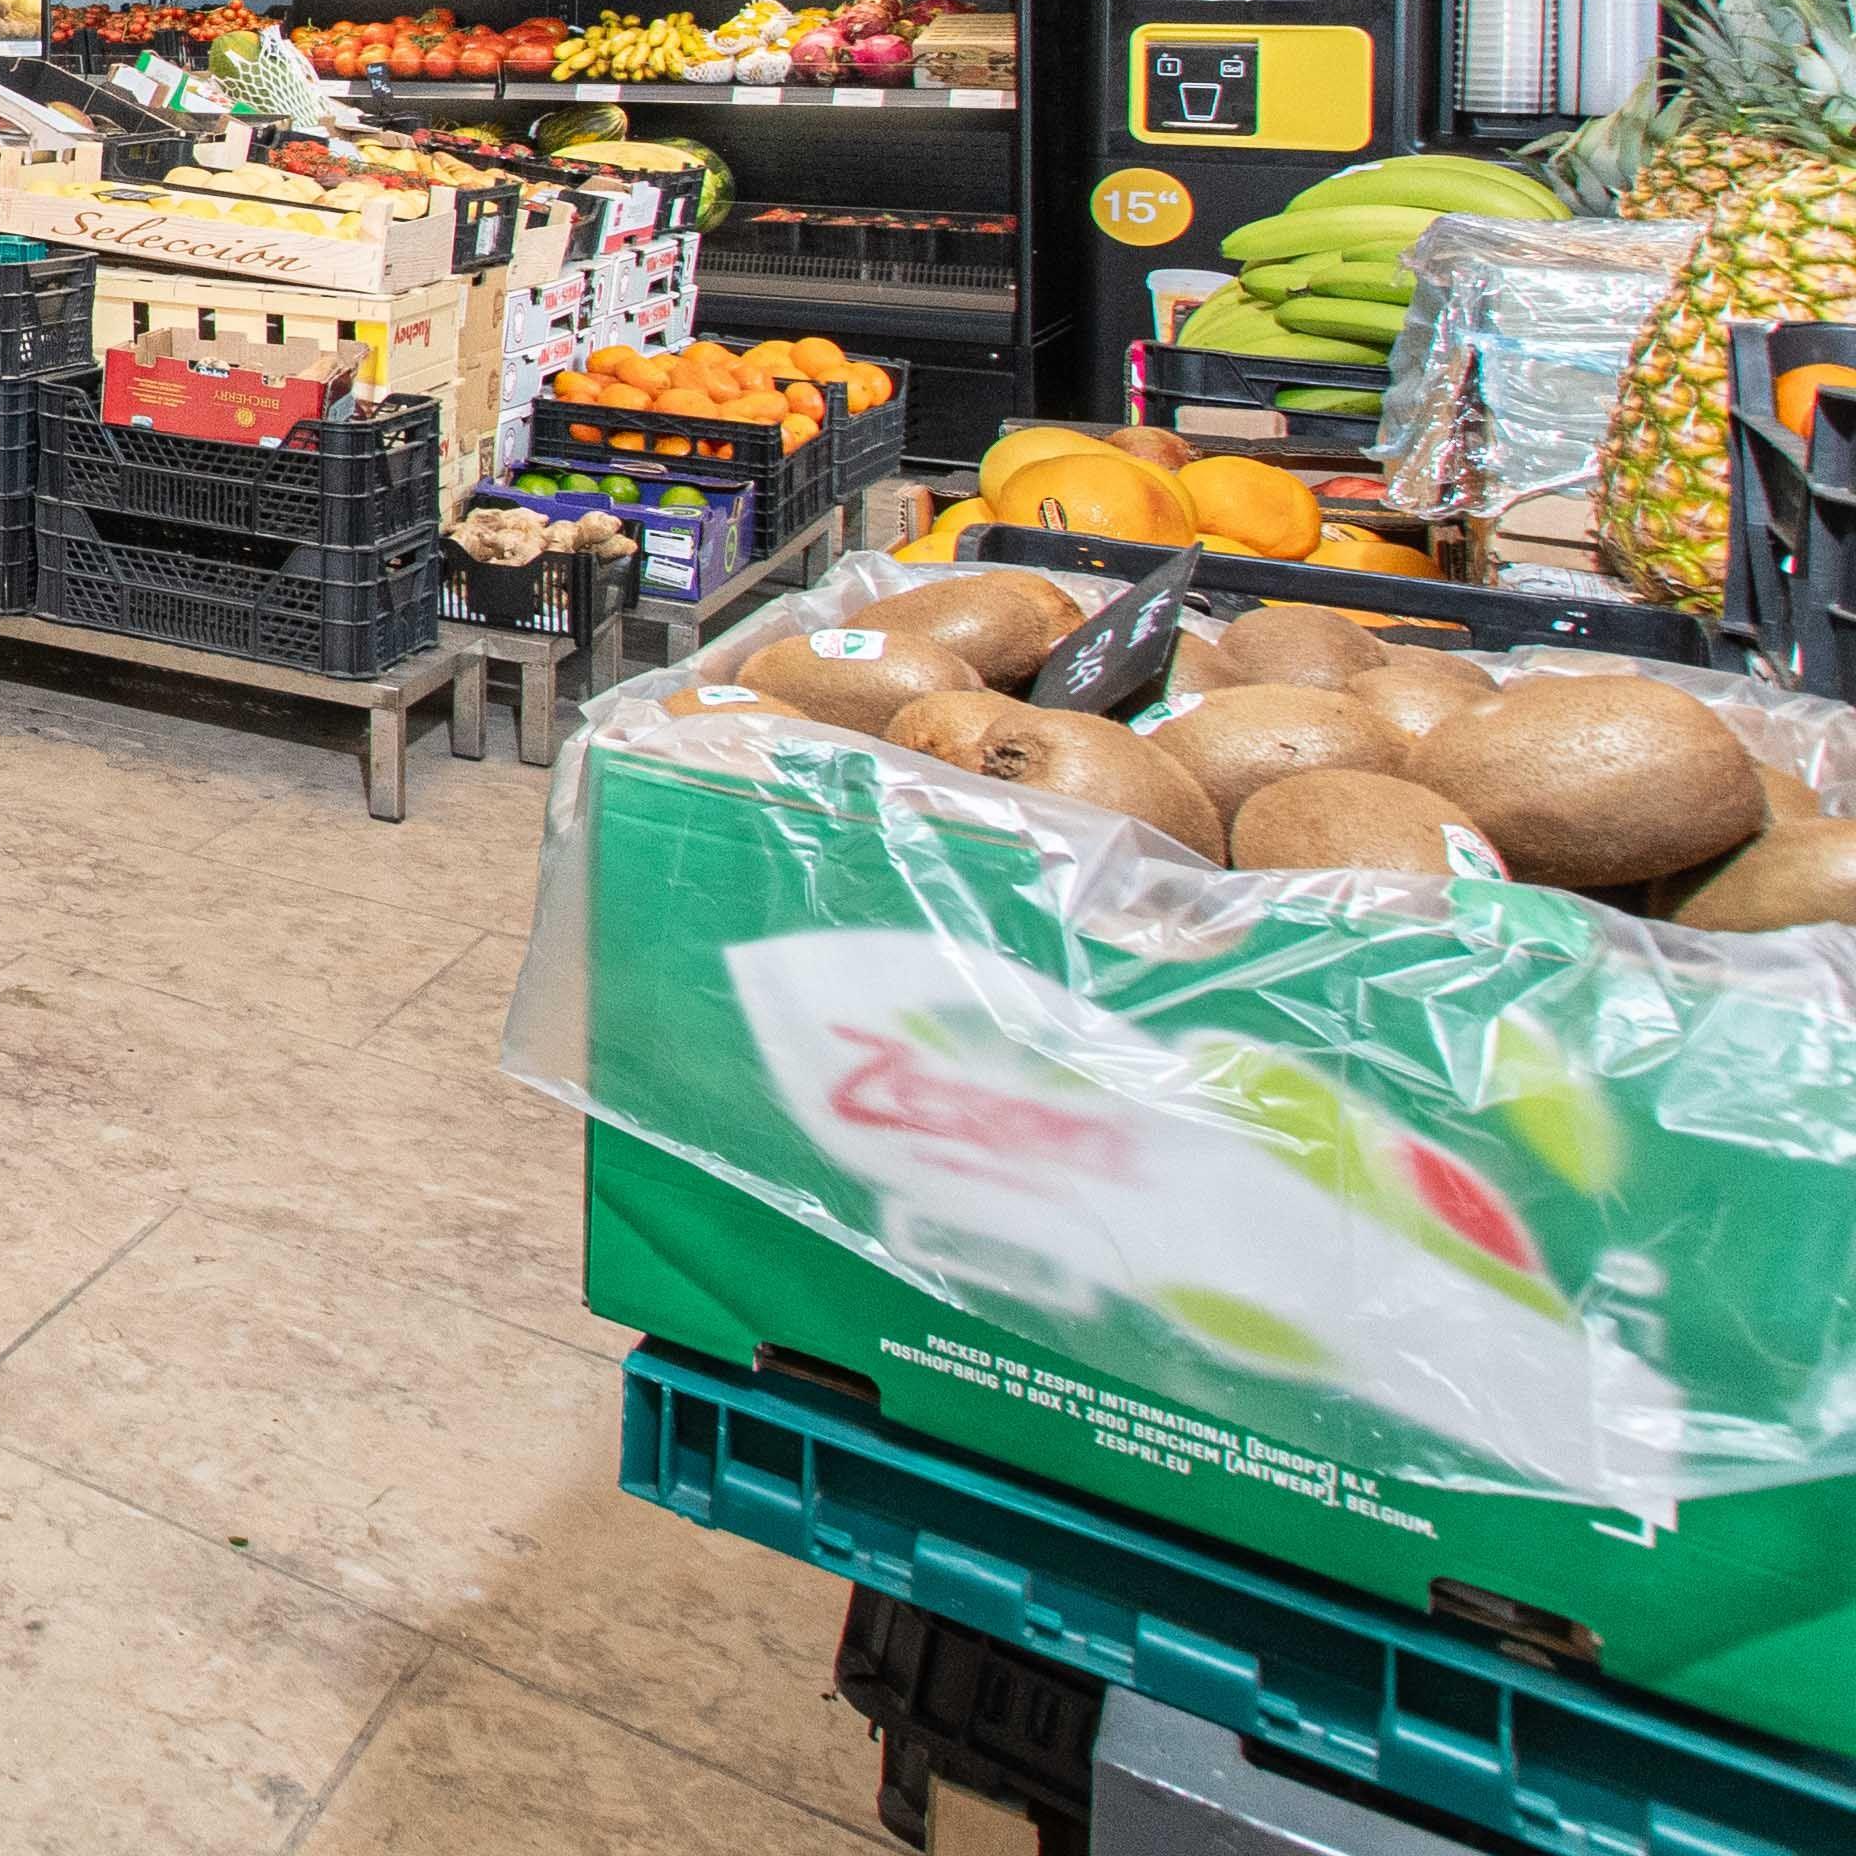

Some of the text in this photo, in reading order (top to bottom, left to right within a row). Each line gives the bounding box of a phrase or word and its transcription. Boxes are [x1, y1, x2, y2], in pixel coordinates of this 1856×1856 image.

[51, 211, 312, 273] Selección
[213, 388, 281, 411] BIRCHERRY
[880, 1337, 1000, 1390] POSTHOFBRUG
[1004, 1379, 1025, 1398] 10
[1027, 1386, 1062, 1413] BOX
[1085, 1406, 1130, 1433] 2600
[1133, 1422, 1222, 1465] BERCHEM
[927, 1333, 992, 1368] PACKED
[995, 1356, 1030, 1381] FOR
[1034, 1368, 1096, 1403] ZESPRI
[1099, 1390, 1242, 1453] INTERNATIONAL
[1342, 1470, 1381, 1498] N.V.
[1093, 1428, 1192, 1476] ZESPRI.EU
